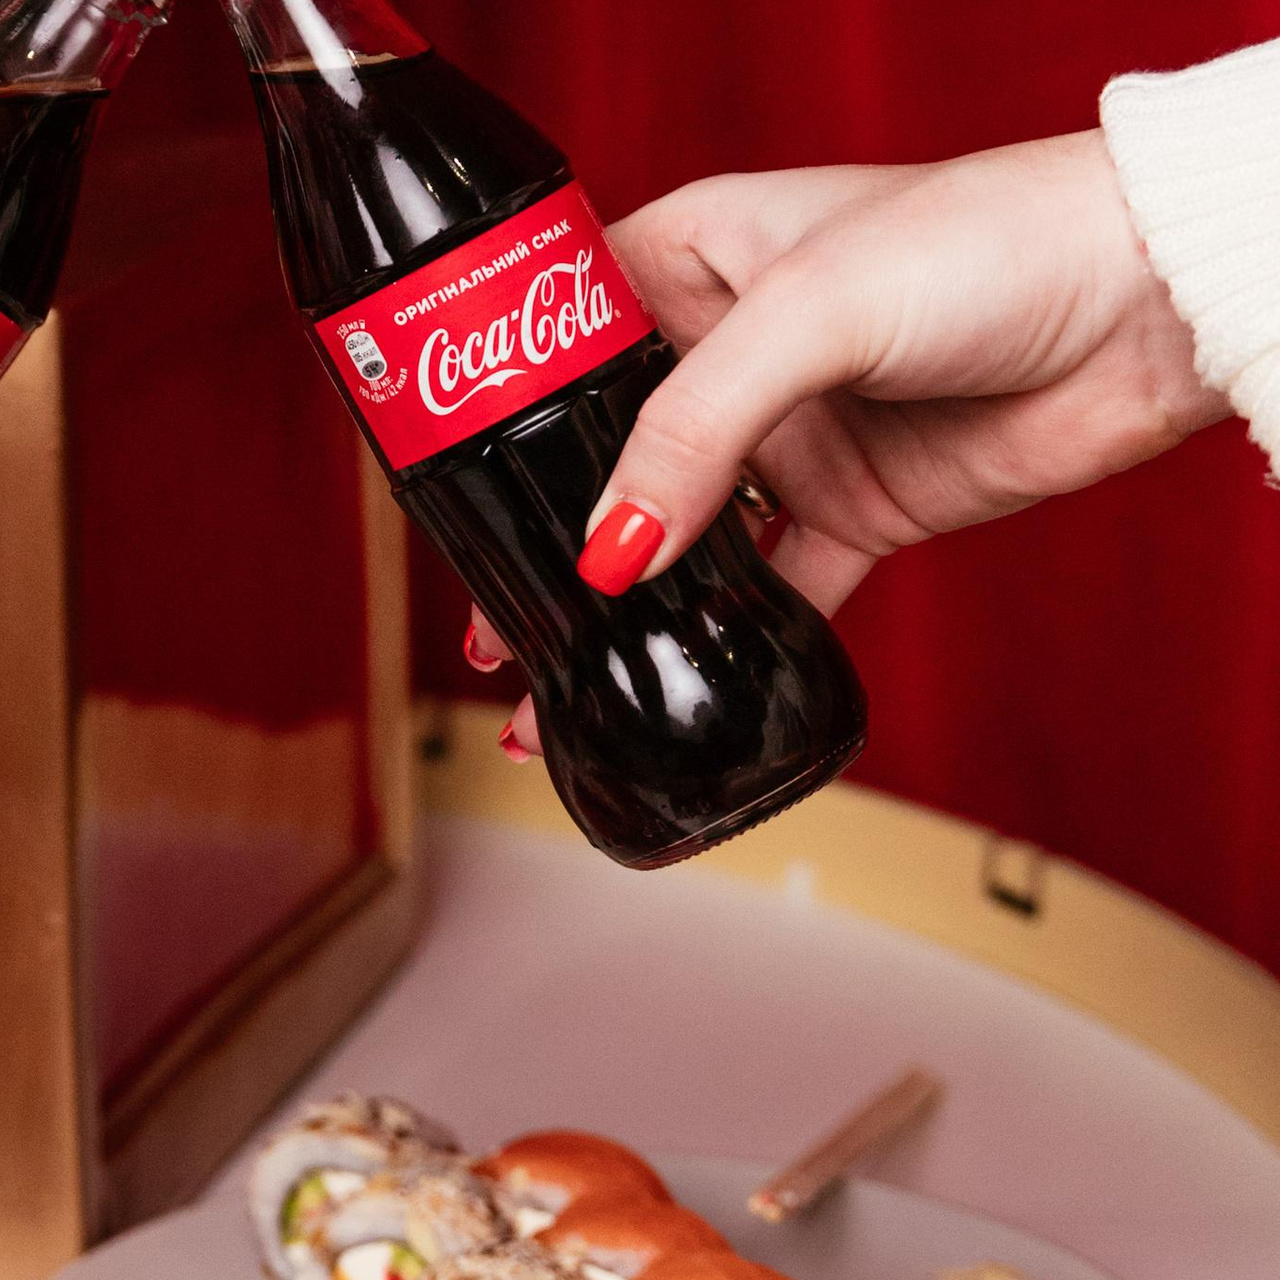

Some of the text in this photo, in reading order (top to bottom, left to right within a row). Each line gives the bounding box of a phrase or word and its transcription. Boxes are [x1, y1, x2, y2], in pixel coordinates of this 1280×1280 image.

[393, 240, 531, 326] ОРИГІНАЛЬНИЙ
[532, 218, 572, 251] СМАК
[418, 244, 613, 416] Coca-Cola
